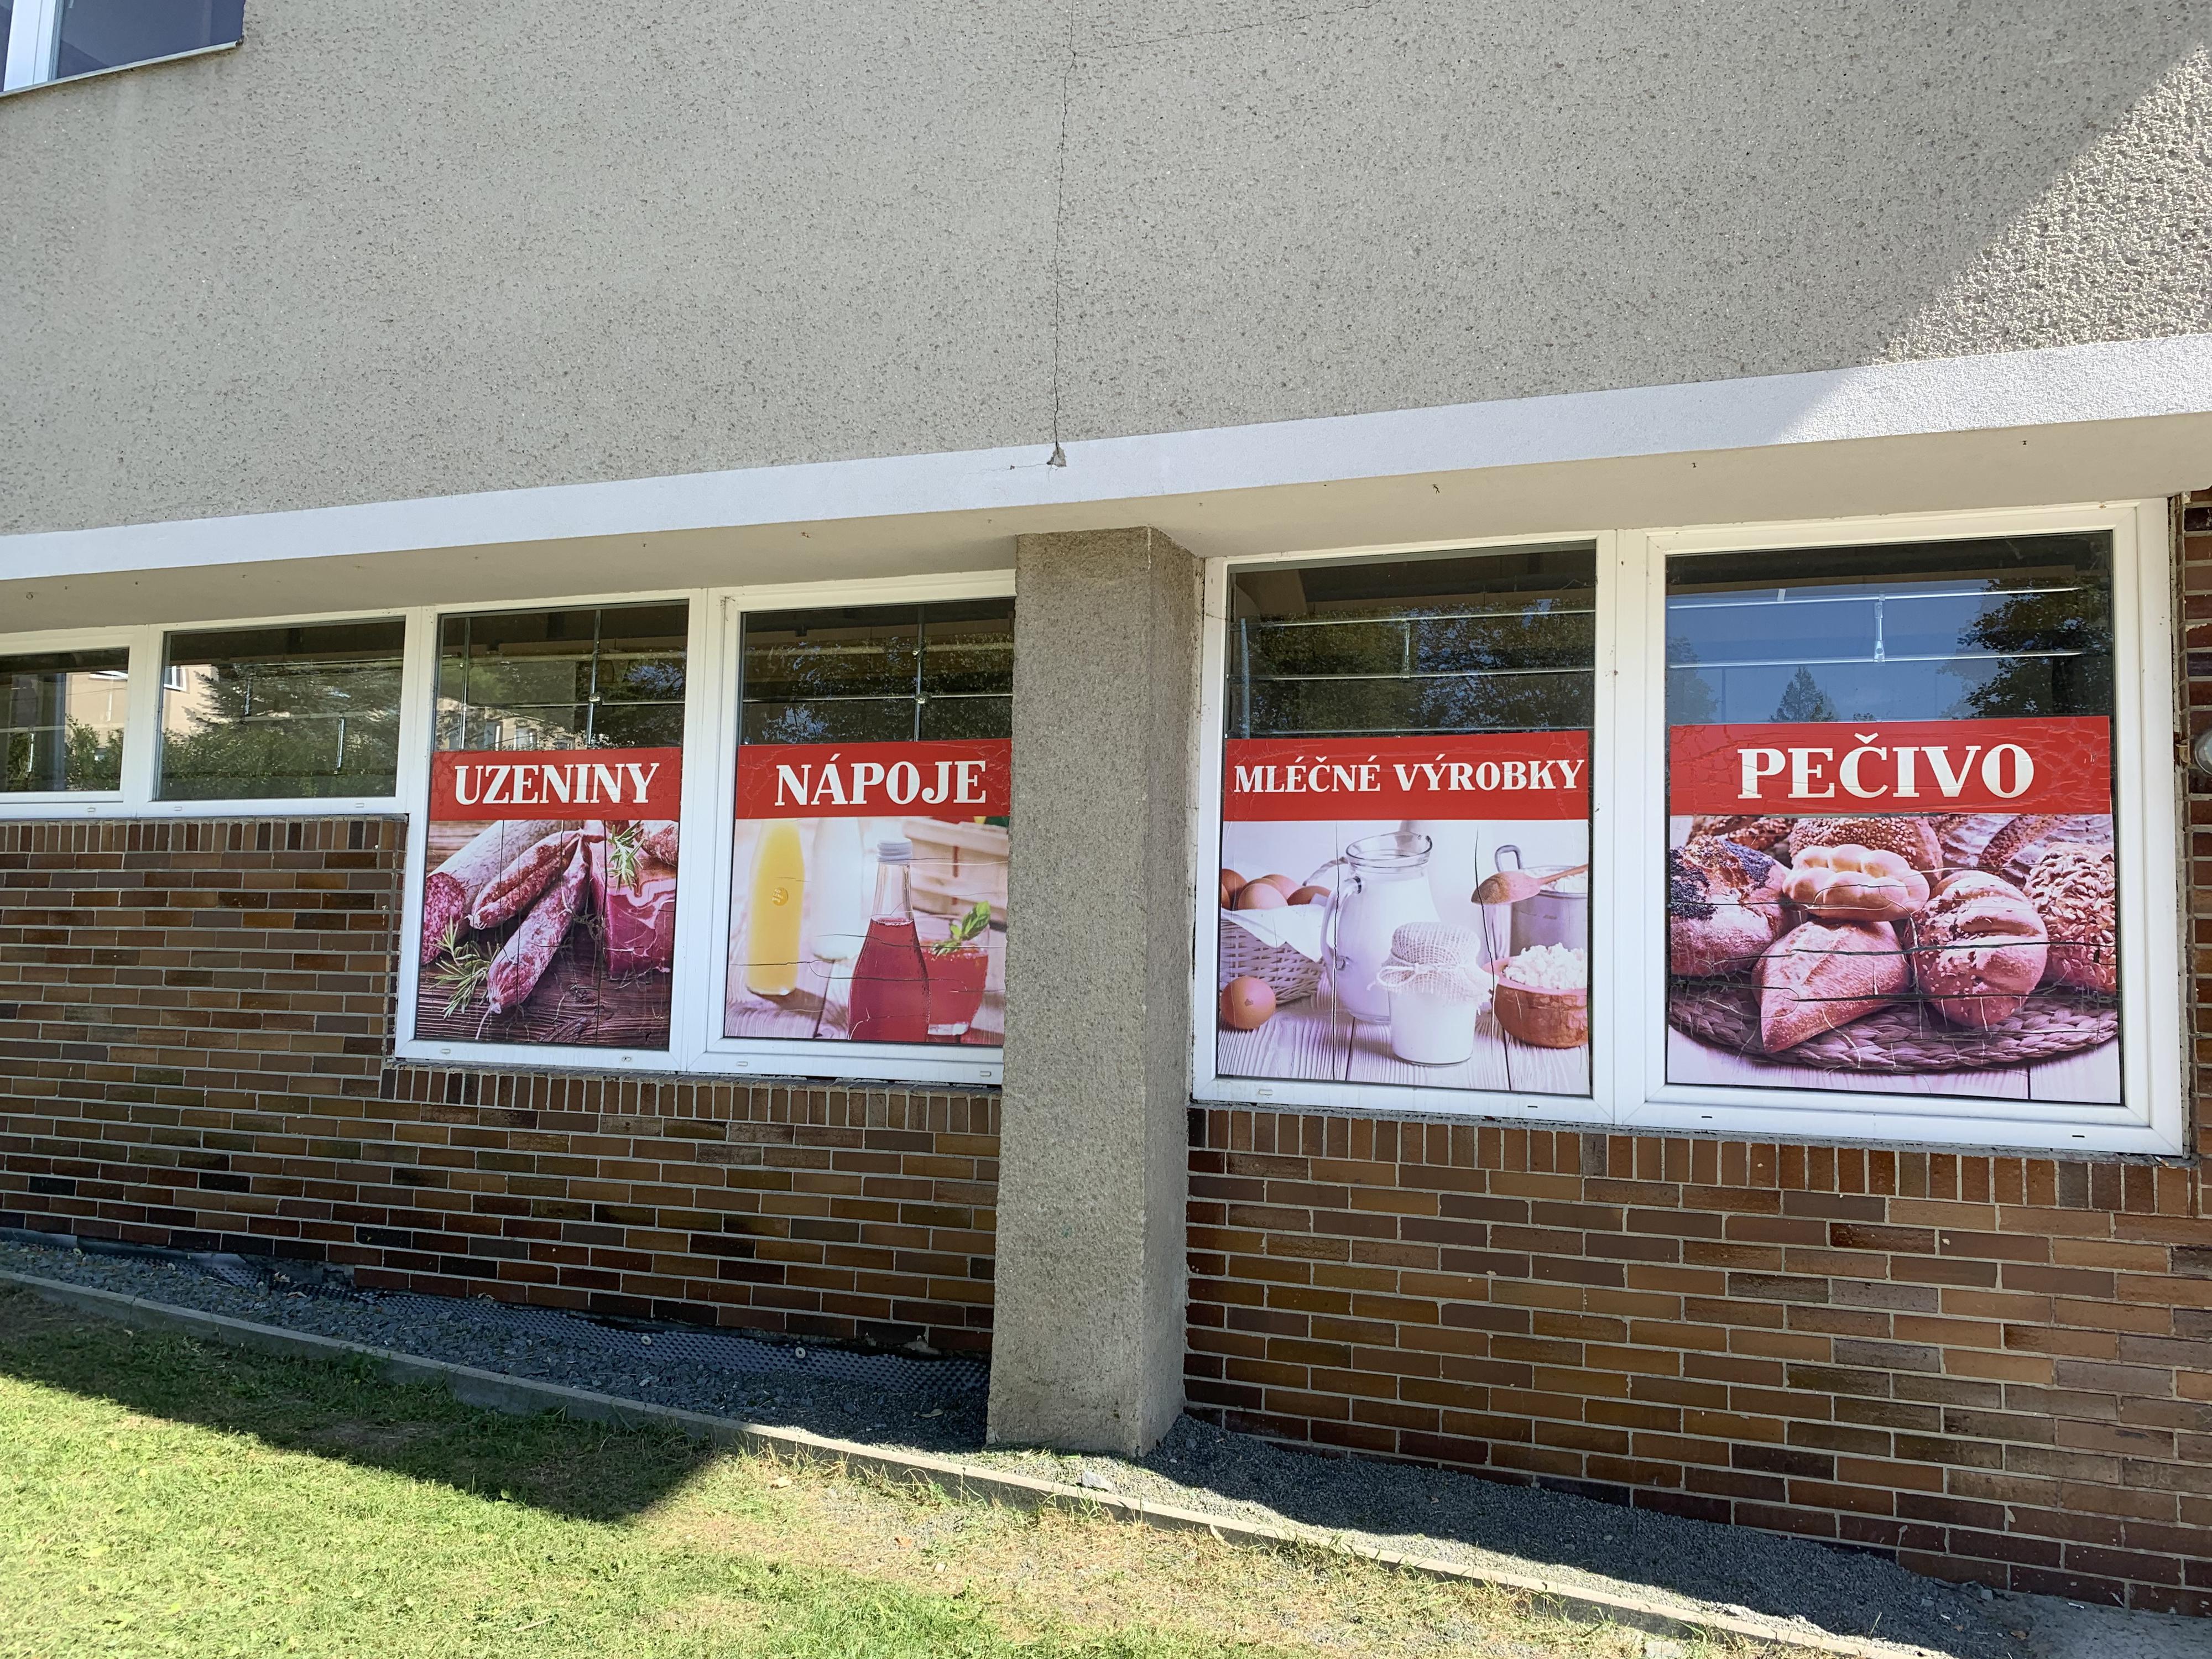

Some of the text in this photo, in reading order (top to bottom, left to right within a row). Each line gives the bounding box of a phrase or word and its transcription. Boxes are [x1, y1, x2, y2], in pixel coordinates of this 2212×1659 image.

[455, 763, 660, 805] UZENINY
[774, 753, 987, 806] NÁPOJE
[1233, 753, 1585, 792] MLÉČNÉ VÝROBKY
[1736, 732, 2035, 800] PEČIVO
